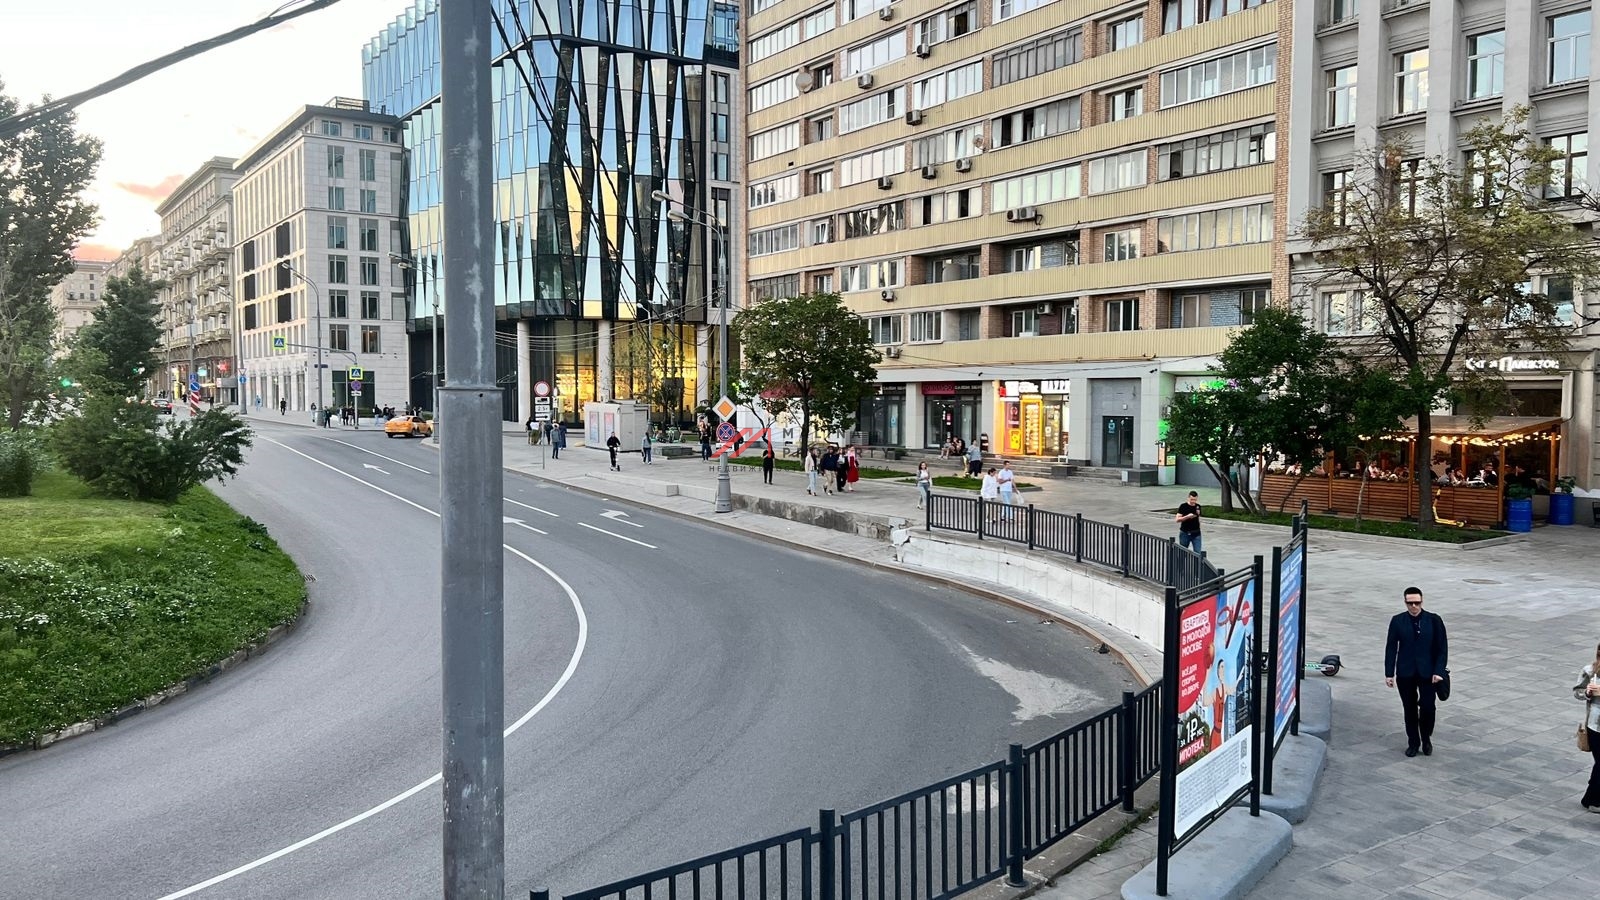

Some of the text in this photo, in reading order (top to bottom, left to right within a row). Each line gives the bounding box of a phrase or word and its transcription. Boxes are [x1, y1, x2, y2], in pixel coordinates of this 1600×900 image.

[1182, 622, 1211, 646] В МОЛОДОЙ
[1182, 640, 1203, 657] МОСКВЕ
[1179, 737, 1205, 765] ИПОТЕКА
